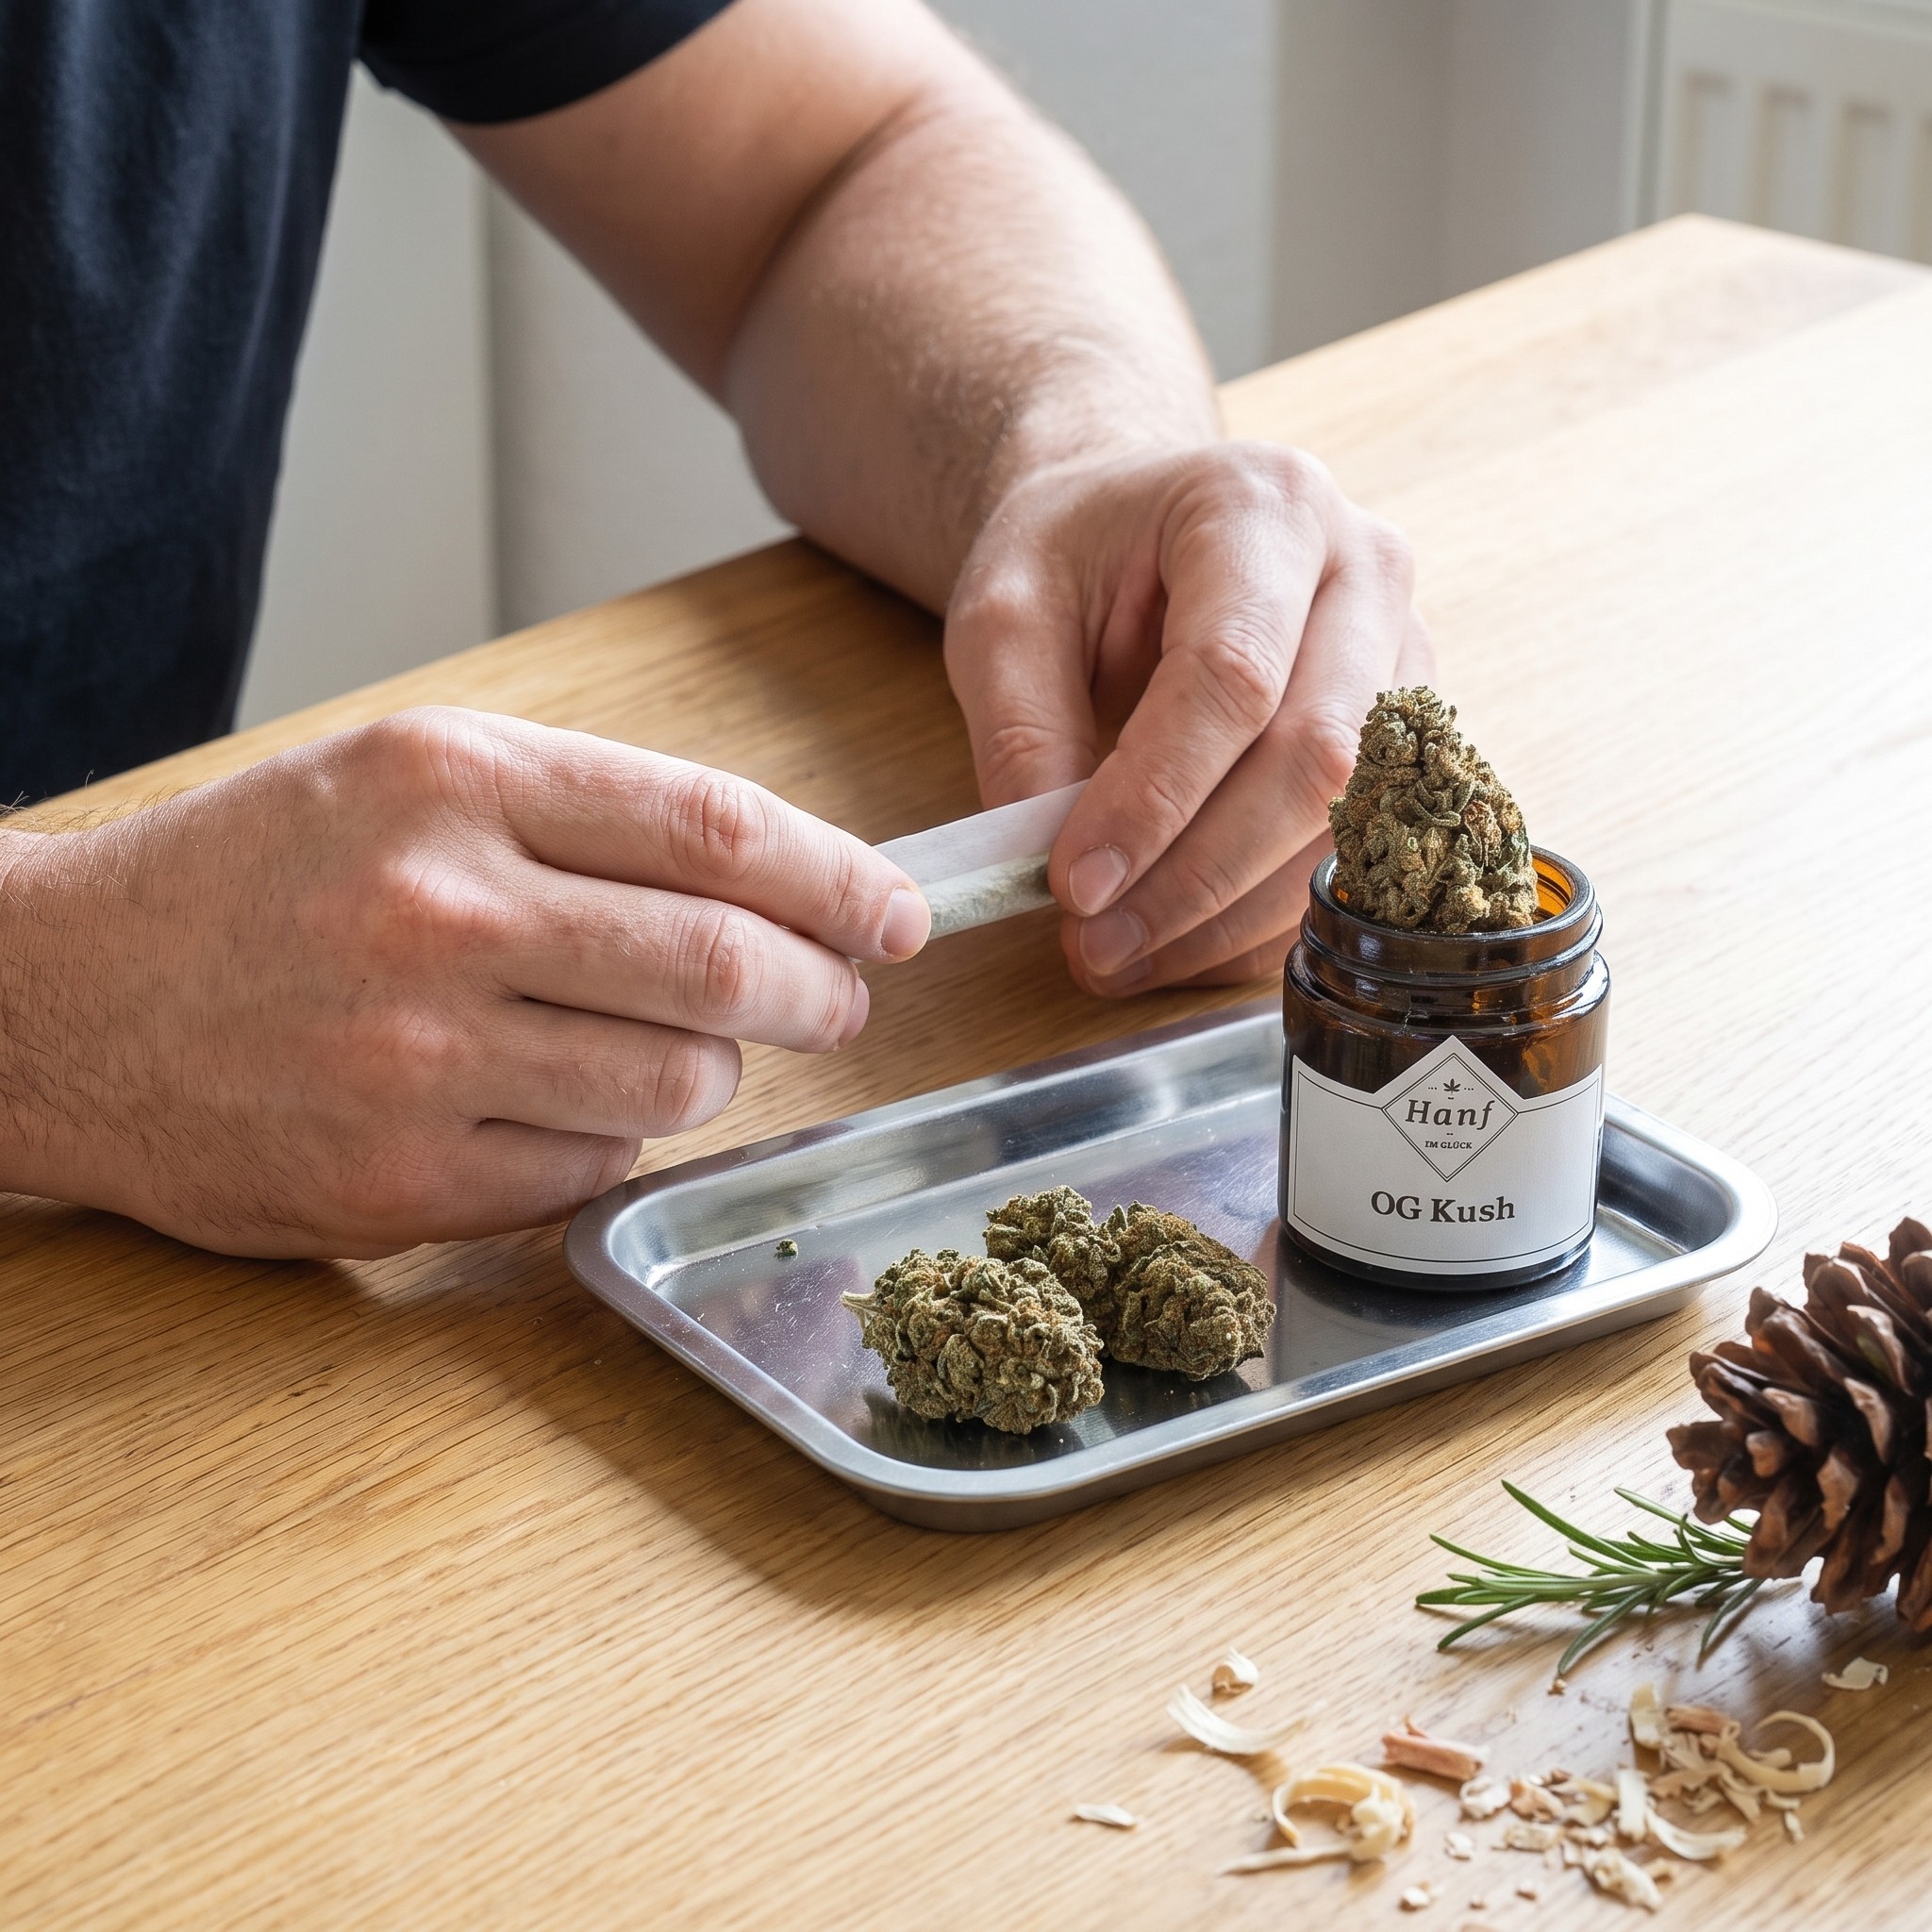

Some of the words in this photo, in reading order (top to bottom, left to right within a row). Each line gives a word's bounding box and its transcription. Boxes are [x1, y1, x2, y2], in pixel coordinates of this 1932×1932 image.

[1405, 1099, 1495, 1130] Hanf
[1424, 1140, 1440, 1149] IM
[1440, 1140, 1473, 1150] GLÜCK
[1371, 1191, 1422, 1220] OG
[1430, 1196, 1515, 1224] Kush
